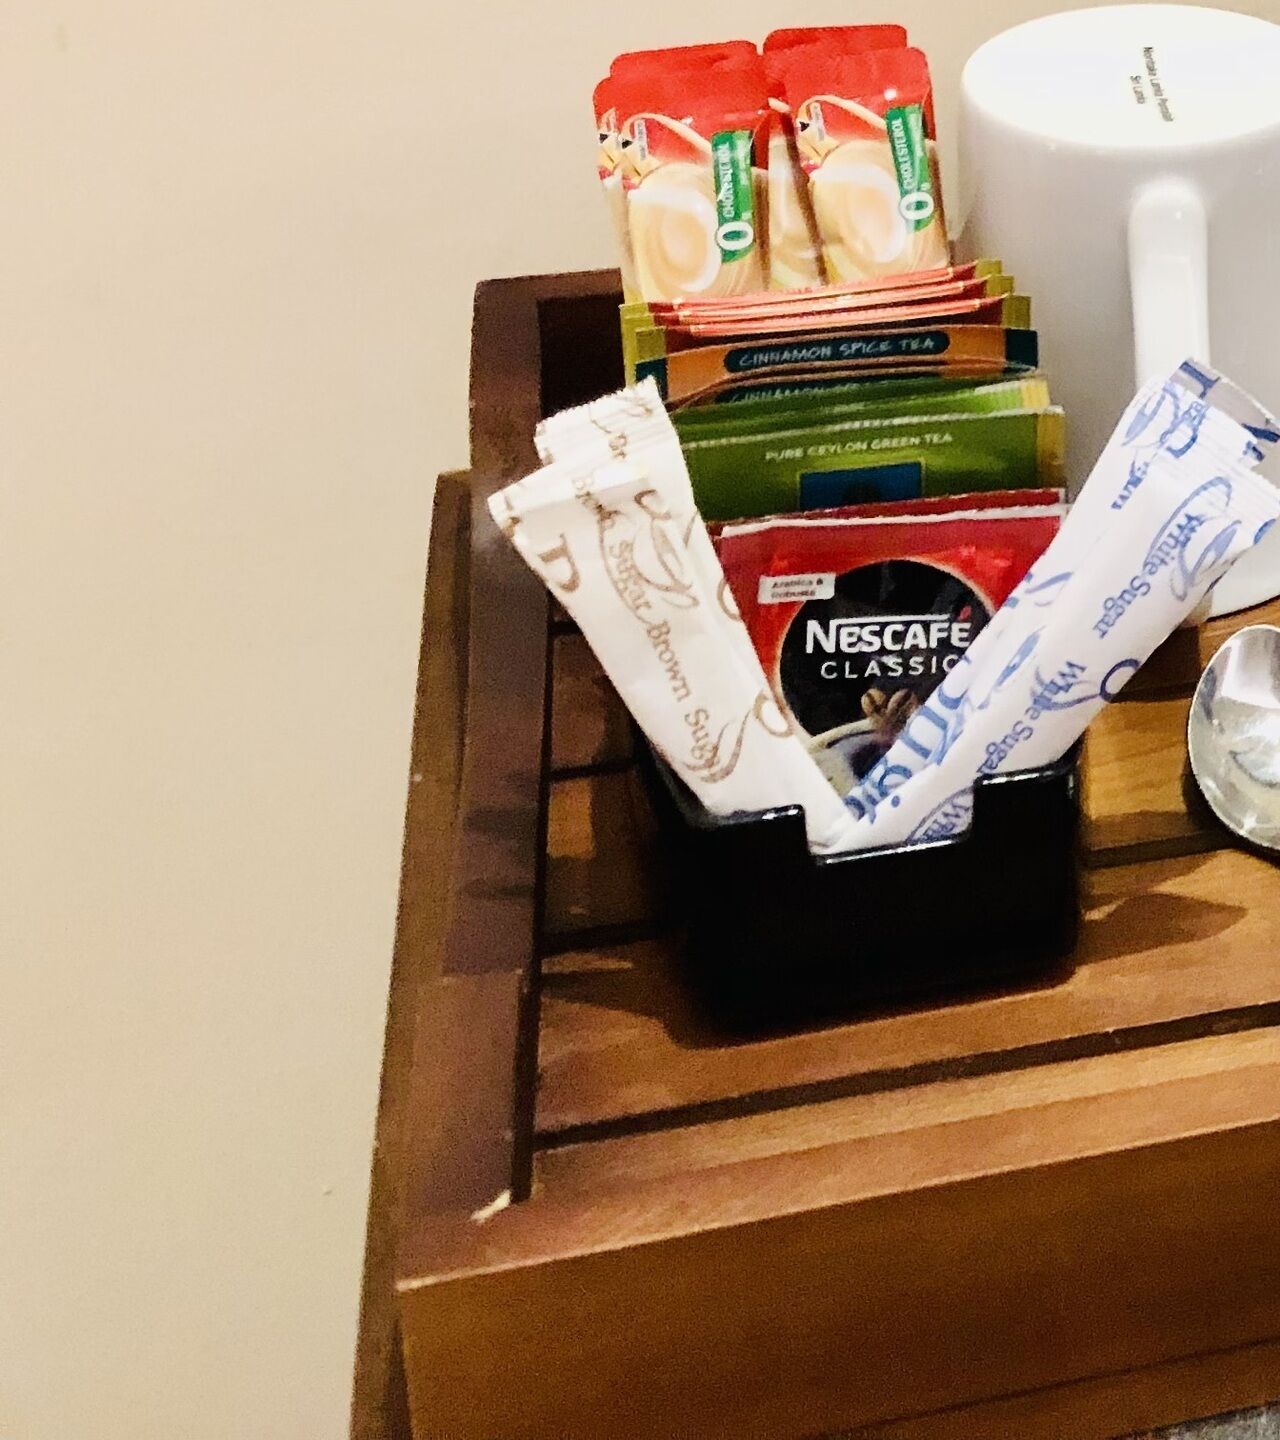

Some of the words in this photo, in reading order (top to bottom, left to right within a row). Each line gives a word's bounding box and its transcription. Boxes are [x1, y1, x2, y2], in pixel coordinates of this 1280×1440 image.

[717, 142, 735, 218] CHOLESTEROL
[891, 116, 916, 191] CHOLESTEROL
[739, 345, 832, 367] CINNAMON
[839, 340, 892, 357] SPICE
[899, 336, 935, 350] TEA
[765, 446, 804, 460] PURE
[807, 440, 868, 456] CEYLON
[871, 436, 921, 451] GREEN
[924, 433, 953, 445] TEA
[1142, 513, 1206, 577] White
[1092, 574, 1151, 639] Sugar
[646, 618, 691, 702] Brown
[820, 654, 961, 680] CLASSIC
